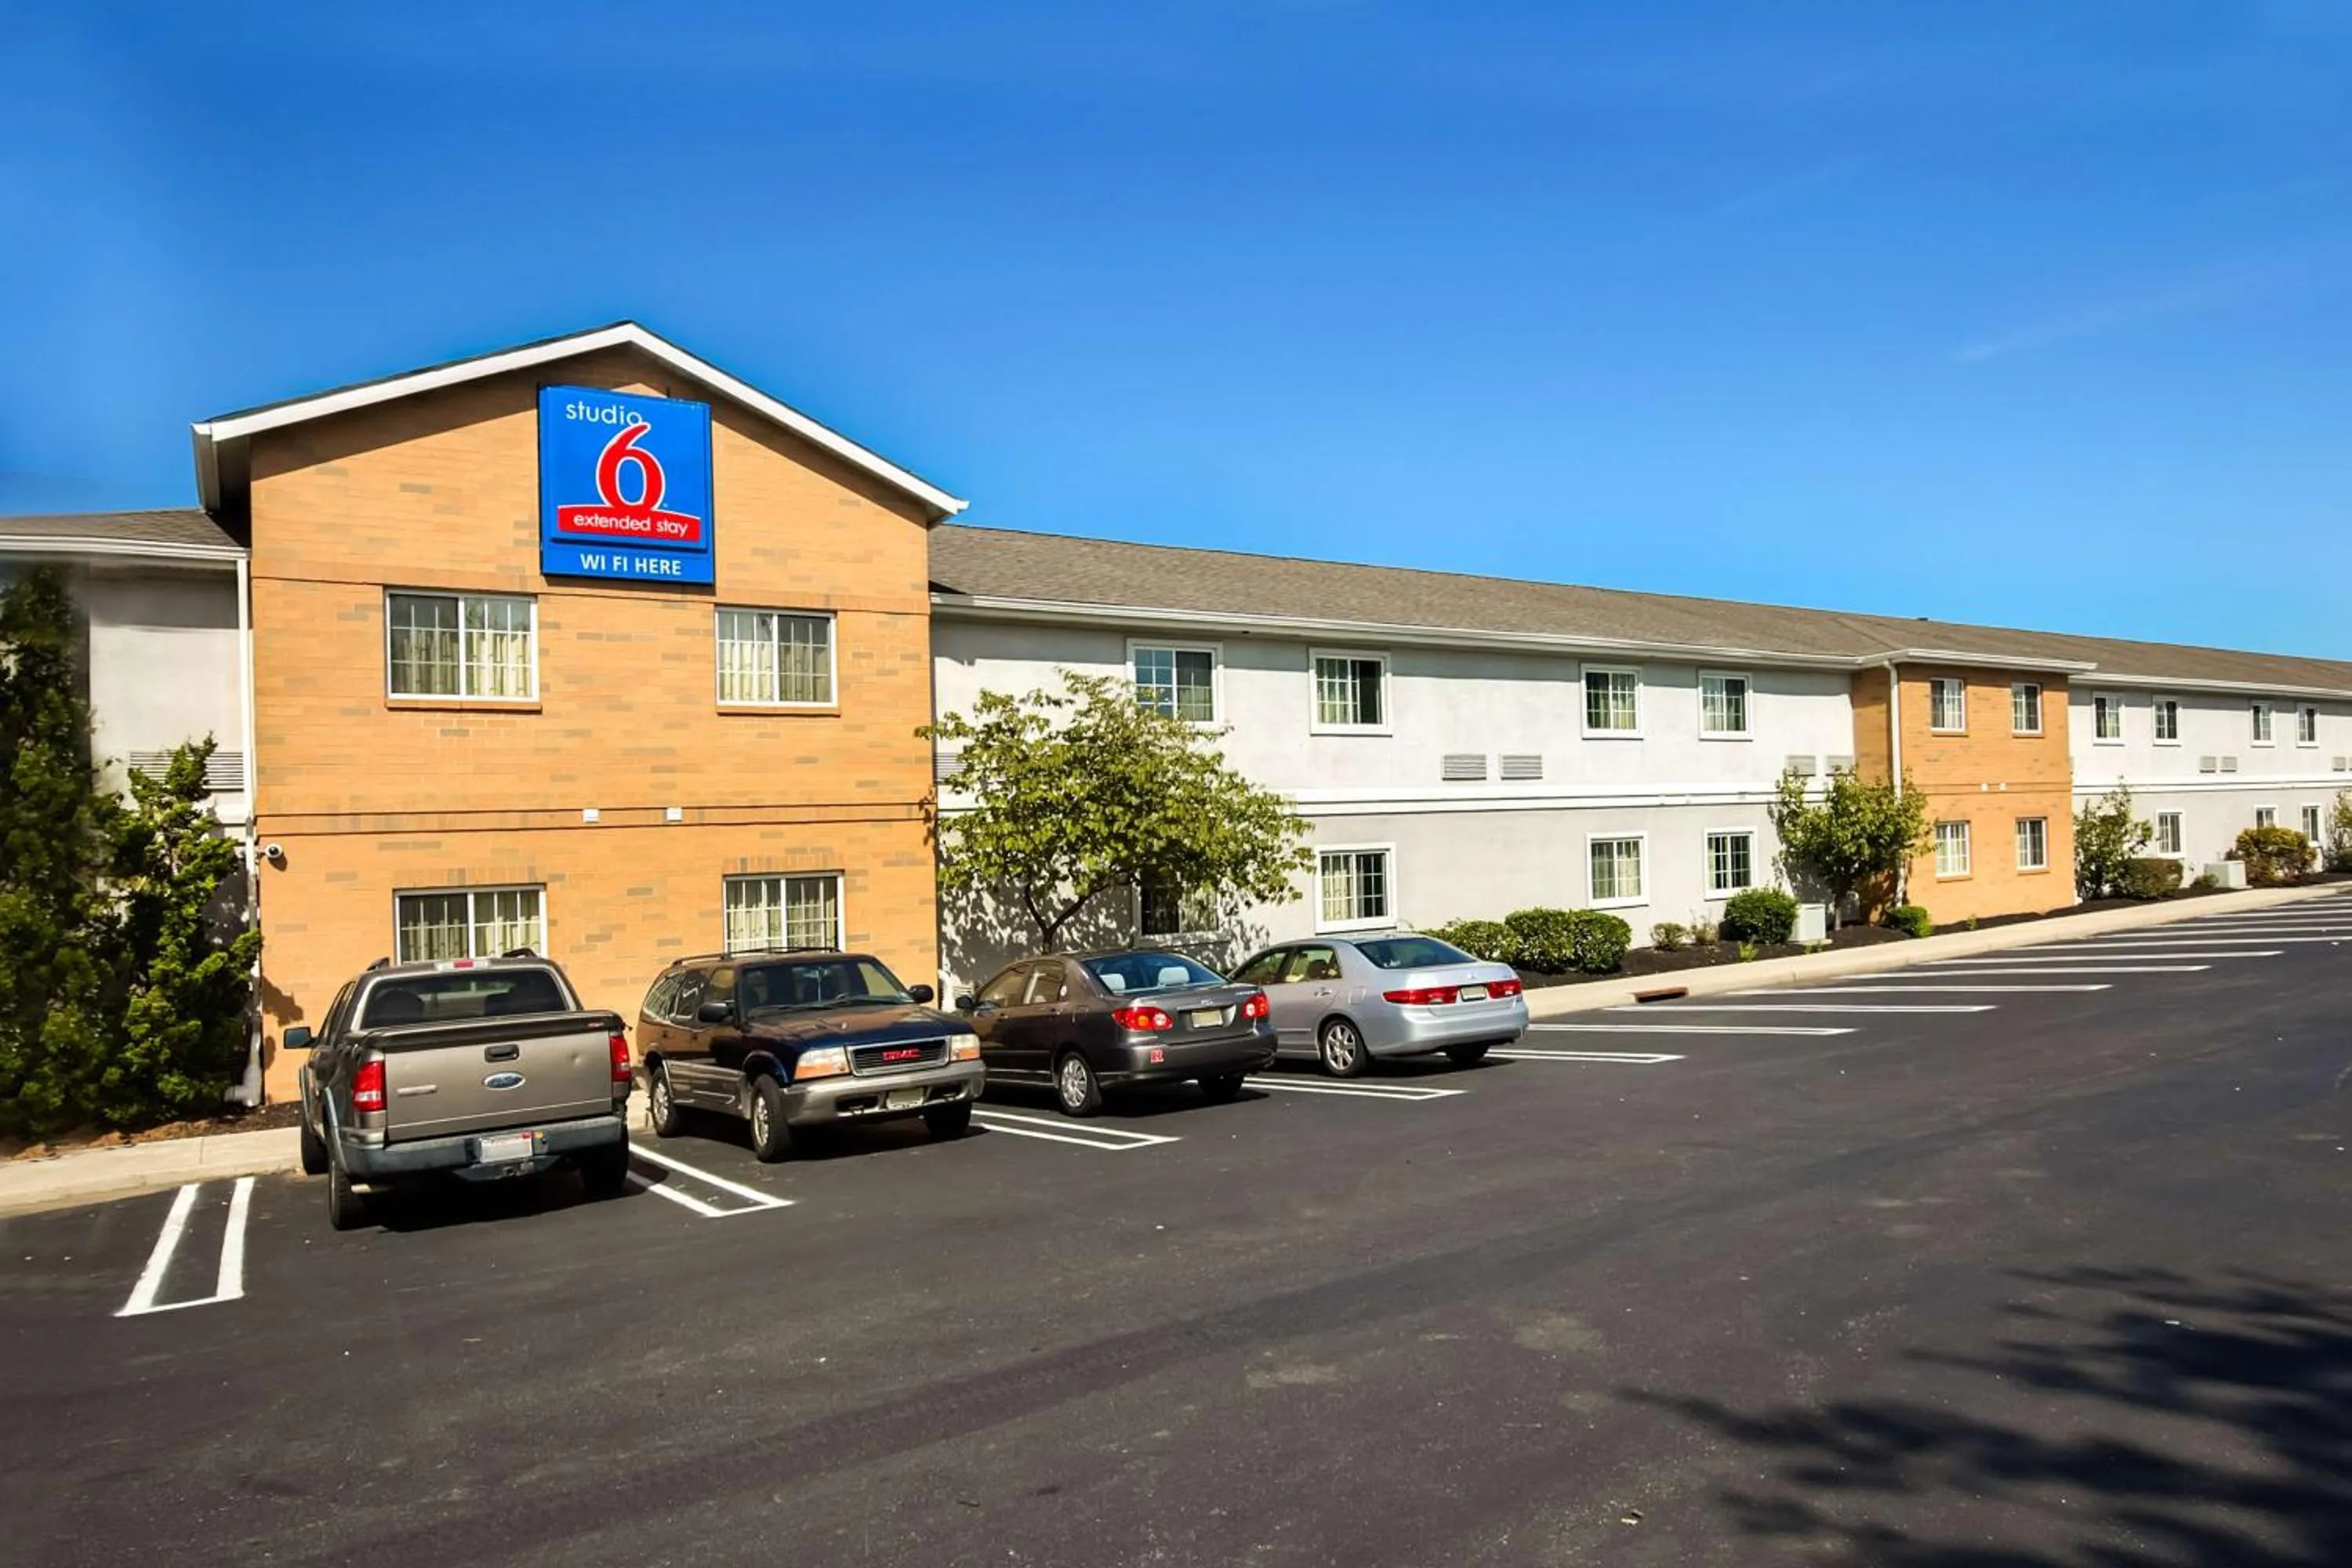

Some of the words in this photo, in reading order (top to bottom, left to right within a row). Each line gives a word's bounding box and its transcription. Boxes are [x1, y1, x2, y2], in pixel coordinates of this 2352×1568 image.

[566, 401, 643, 426] studio
[596, 422, 666, 510] 6
[573, 514, 652, 532] extended
[656, 519, 688, 538] stay
[580, 554, 606, 571] WI
[613, 556, 628, 572] FI
[635, 557, 682, 576] HERE
[882, 1049, 921, 1062] GMC
